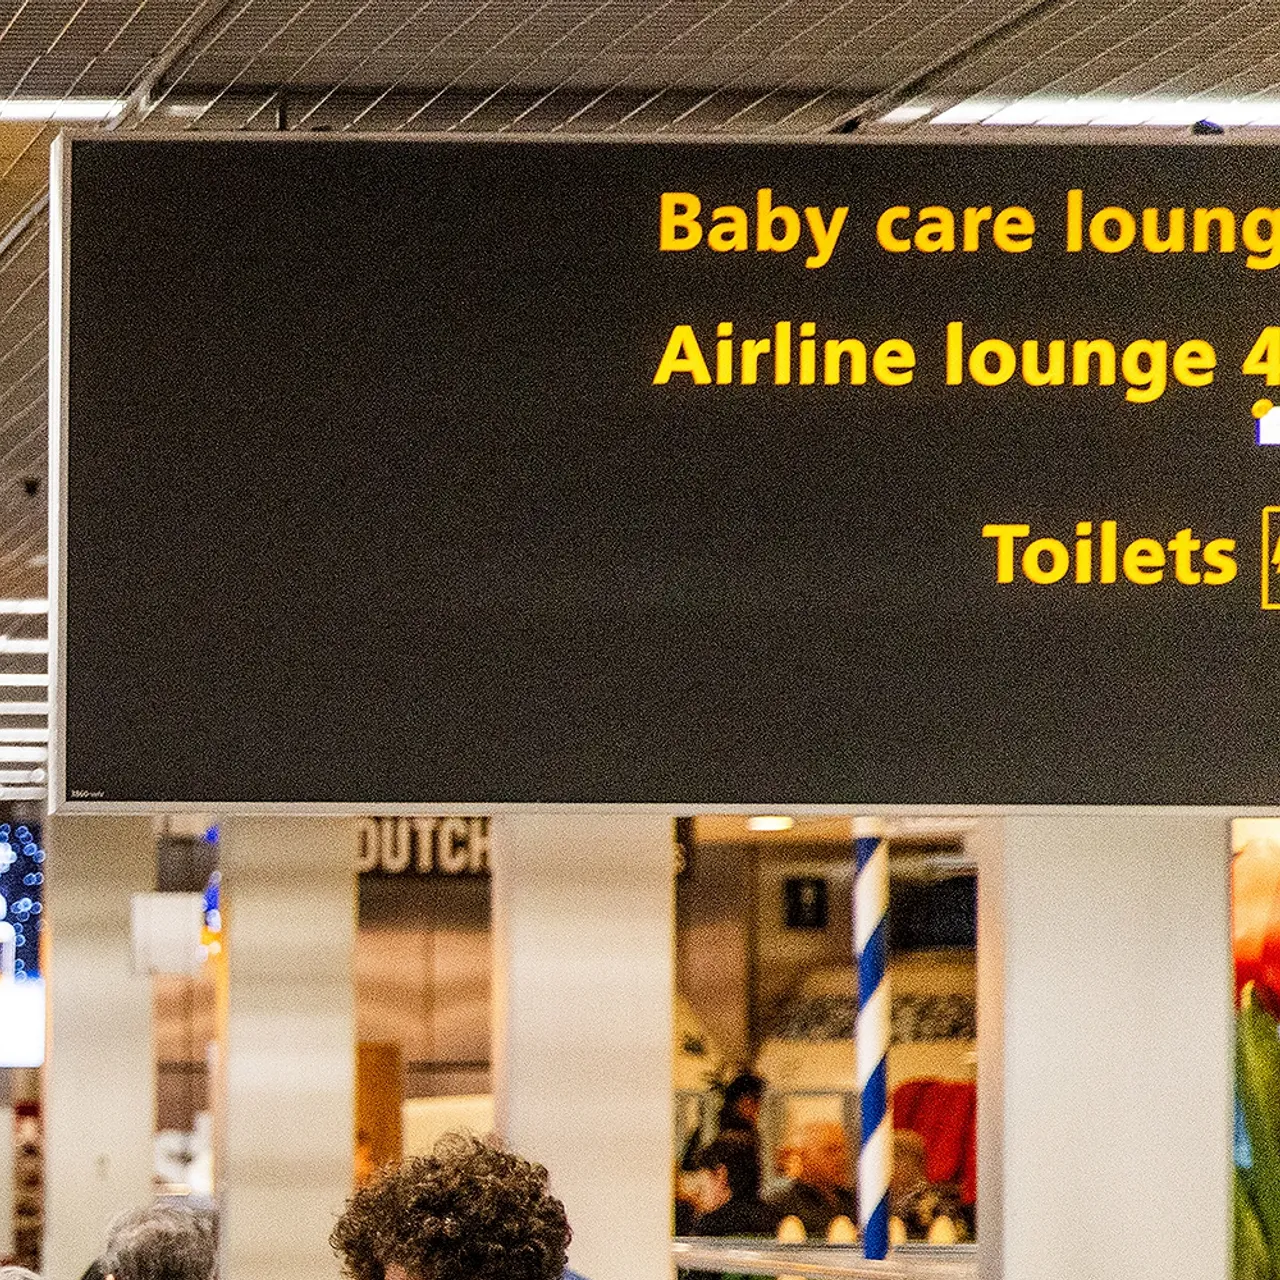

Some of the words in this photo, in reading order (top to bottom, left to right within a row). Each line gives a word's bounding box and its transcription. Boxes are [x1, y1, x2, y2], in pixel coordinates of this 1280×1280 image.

[660, 189, 848, 269] Baby
[877, 206, 1035, 253] care
[653, 321, 916, 386] Airline
[946, 322, 1217, 403] lounge
[982, 520, 1238, 585] Toilets
